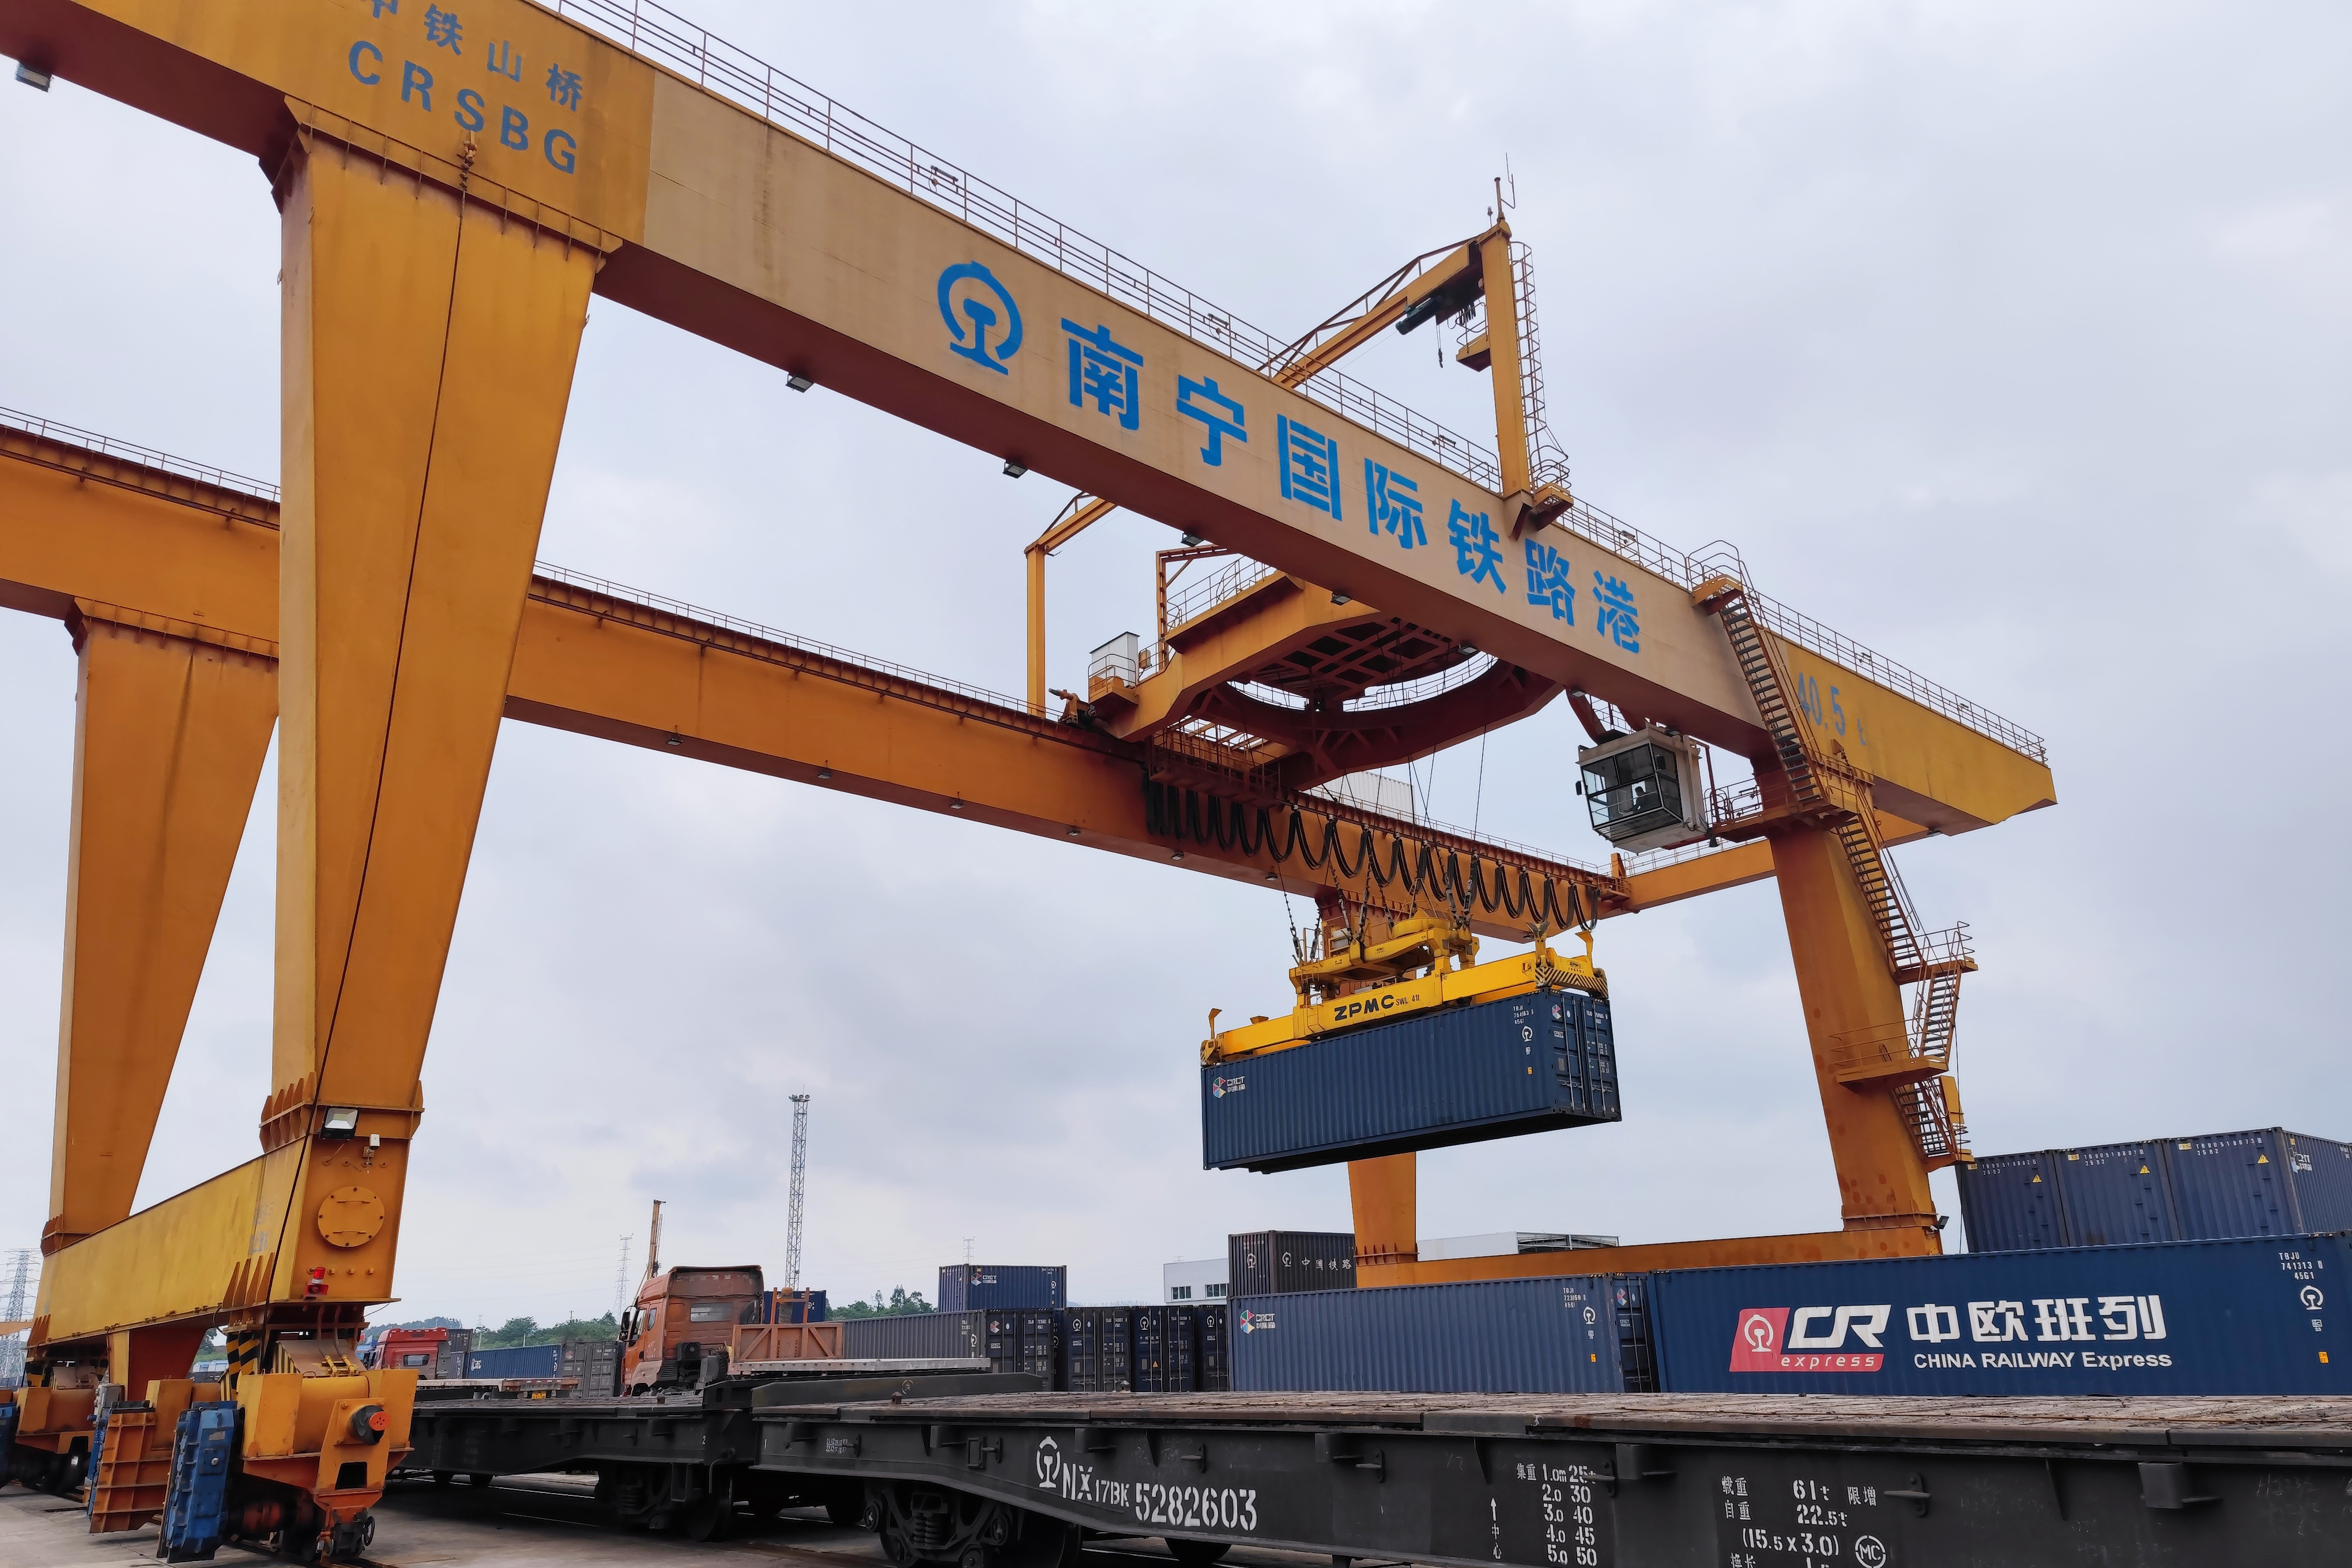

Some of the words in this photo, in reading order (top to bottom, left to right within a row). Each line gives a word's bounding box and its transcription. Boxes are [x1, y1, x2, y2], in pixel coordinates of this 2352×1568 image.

[348, 40, 577, 175] CRSBG
[1061, 318, 1641, 654] 南宁国际铁路港
[1334, 995, 1394, 1022] ZPMC
[1396, 998, 1409, 1007] SWL
[1227, 1076, 1245, 1087] CRCT
[1301, 1257, 1352, 1271] 中国铁路
[2279, 1252, 2300, 1261] TBJU
[2281, 1261, 2312, 1271] 741313
[2294, 1271, 2315, 1280] 45G1
[1256, 1313, 1276, 1322] CRCT
[1788, 1304, 1892, 1349] CR
[1906, 1295, 2167, 1344] 中欧班列
[1780, 1354, 1876, 1370] express
[1913, 1353, 1977, 1369] CHINA
[1982, 1352, 2075, 1369] RAILWAY
[2082, 1352, 2173, 1371] Express
[1516, 1462, 1537, 1482] 集重
[1541, 1463, 1567, 1483] 1.0m
[1541, 1483, 1562, 1502] 2.0
[1570, 1484, 1592, 1504] 30
[1721, 1475, 1748, 1497] 载重
[1793, 1479, 1830, 1501] 61t
[1846, 1485, 1877, 1507] 限增
[1135, 1482, 1258, 1532] 5282603
[1543, 1502, 1564, 1522] 3.0
[1573, 1505, 1593, 1525] 40
[1724, 1499, 1752, 1521] 自重
[1796, 1503, 1848, 1528] 22.5t
[1491, 1522, 1502, 1560] 中心
[1546, 1524, 1566, 1543] 4.0
[1574, 1526, 1596, 1546] 45
[1547, 1544, 1568, 1565] 5.0
[1575, 1546, 1598, 1567] 50
[1859, 1543, 1882, 1561] MC
